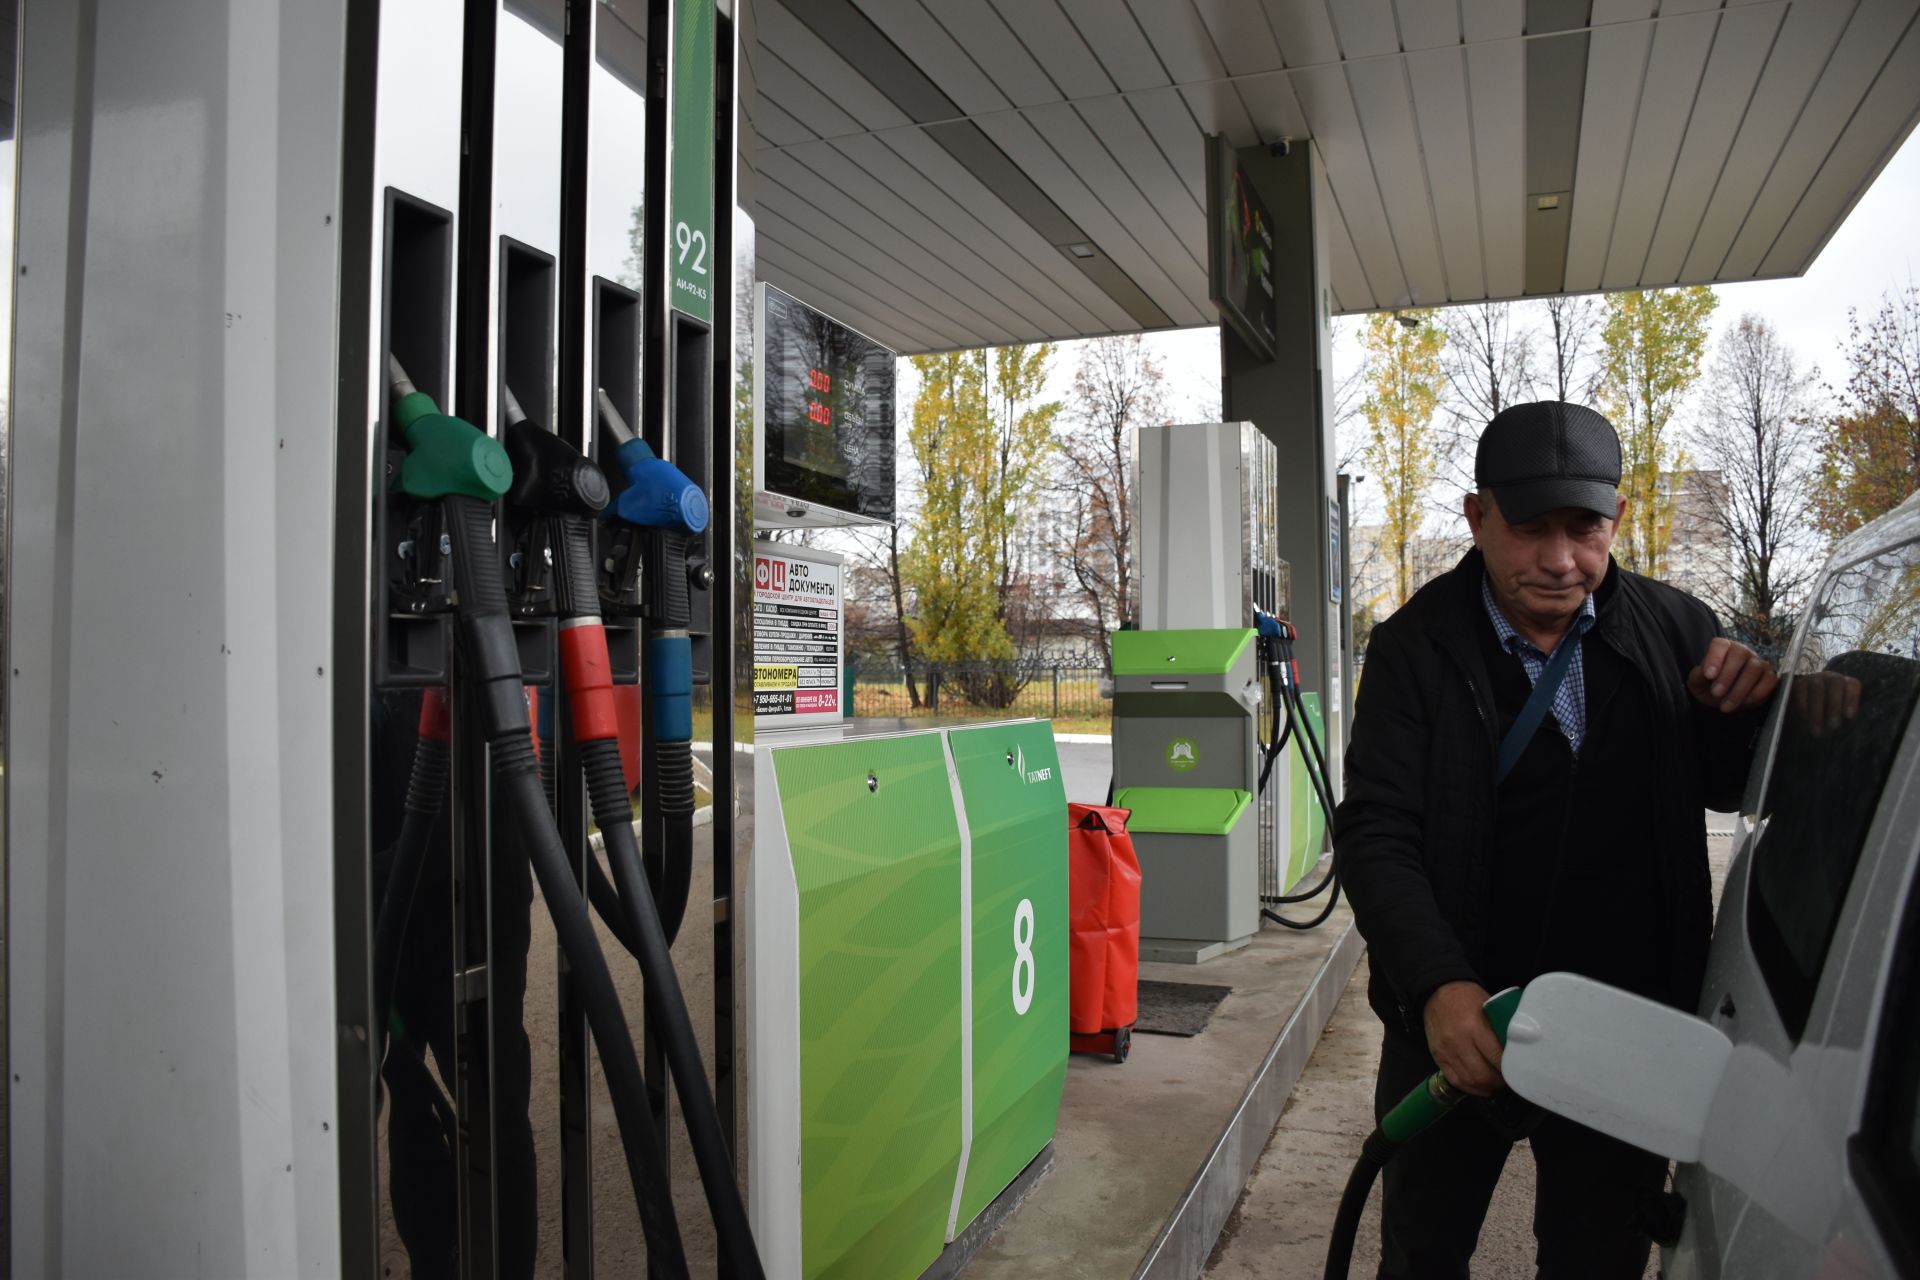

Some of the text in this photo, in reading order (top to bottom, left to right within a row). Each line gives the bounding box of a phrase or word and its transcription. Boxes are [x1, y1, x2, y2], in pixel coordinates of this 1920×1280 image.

[676, 221, 707, 275] 92
[676, 278, 707, 300] АИ-92-К5
[789, 564, 808, 577] АВТО
[789, 579, 834, 596] ДОКУМЕНТЫ
[757, 592, 780, 600] ГОРОДСКОЙ
[781, 593, 794, 601] ЦЕНТР
[1027, 767, 1052, 784] TATNEFT
[1012, 898, 1035, 1016] 8
